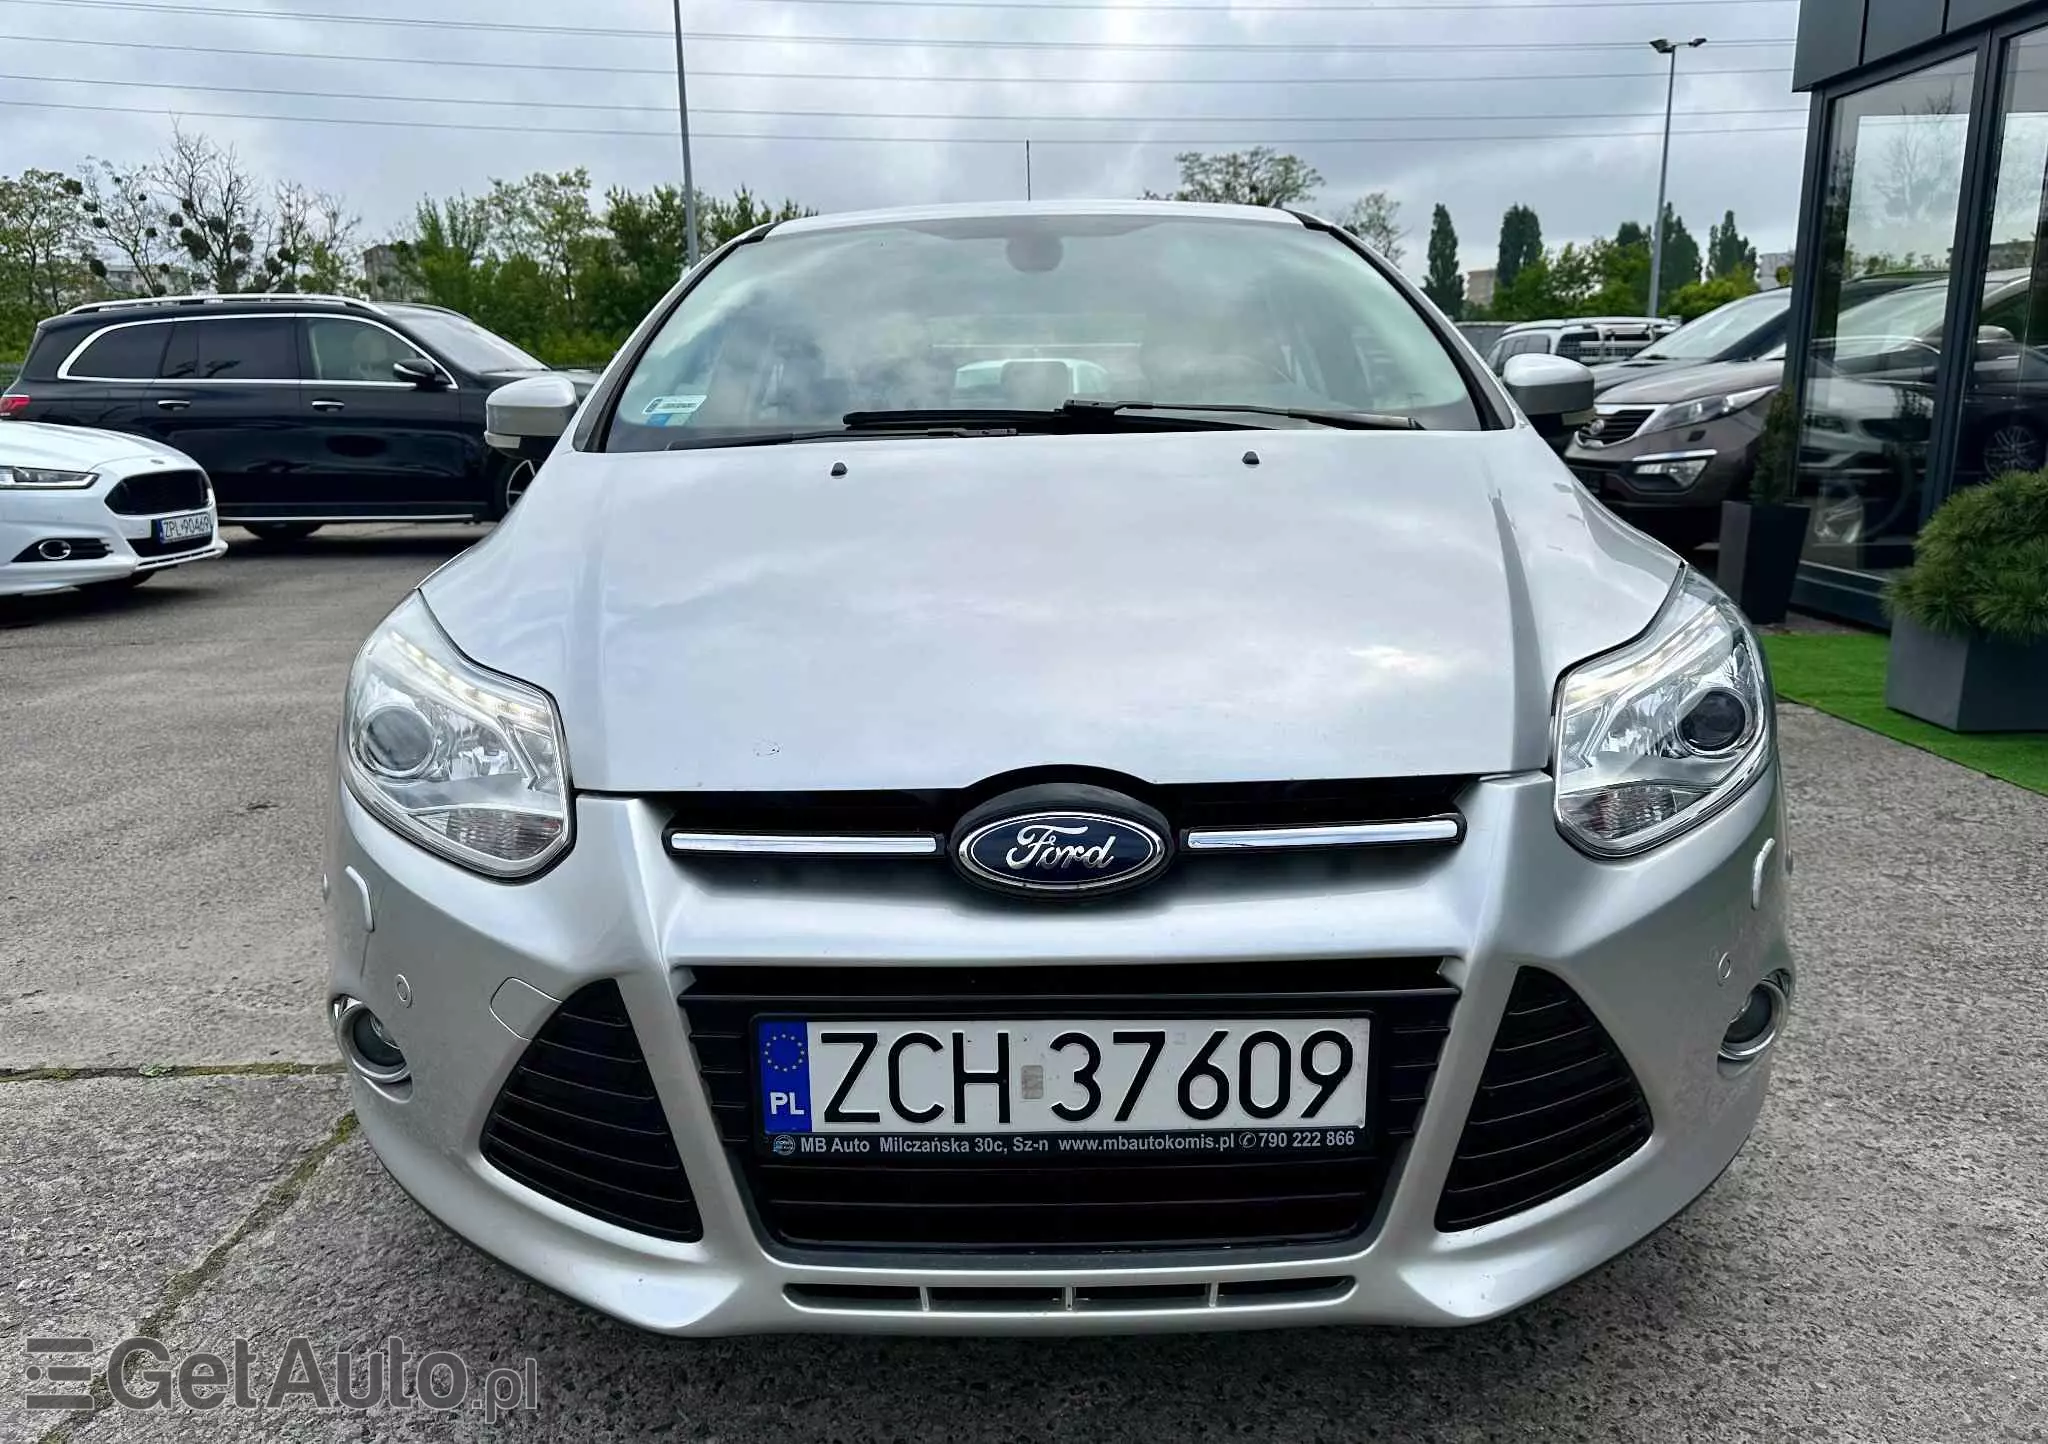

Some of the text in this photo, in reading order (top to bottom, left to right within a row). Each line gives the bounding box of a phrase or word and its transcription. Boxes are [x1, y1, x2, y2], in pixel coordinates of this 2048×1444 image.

[163, 519, 181, 538] ZPL
[1005, 824, 1116, 870] Ford
[819, 1029, 1355, 1125] ZCH 37609
[769, 1091, 805, 1115] PL
[801, 1137, 826, 1152] MB
[831, 1138, 870, 1153] Auto
[879, 1137, 970, 1153] Milczańska
[974, 1138, 1008, 1154] 30c,
[1012, 1137, 1049, 1151] Sz-n
[1058, 1133, 1235, 1151] www.mbautokomis.pl
[1258, 1132, 1287, 1147] 790
[1292, 1132, 1321, 1147] 222
[1326, 1130, 1355, 1146] 866
